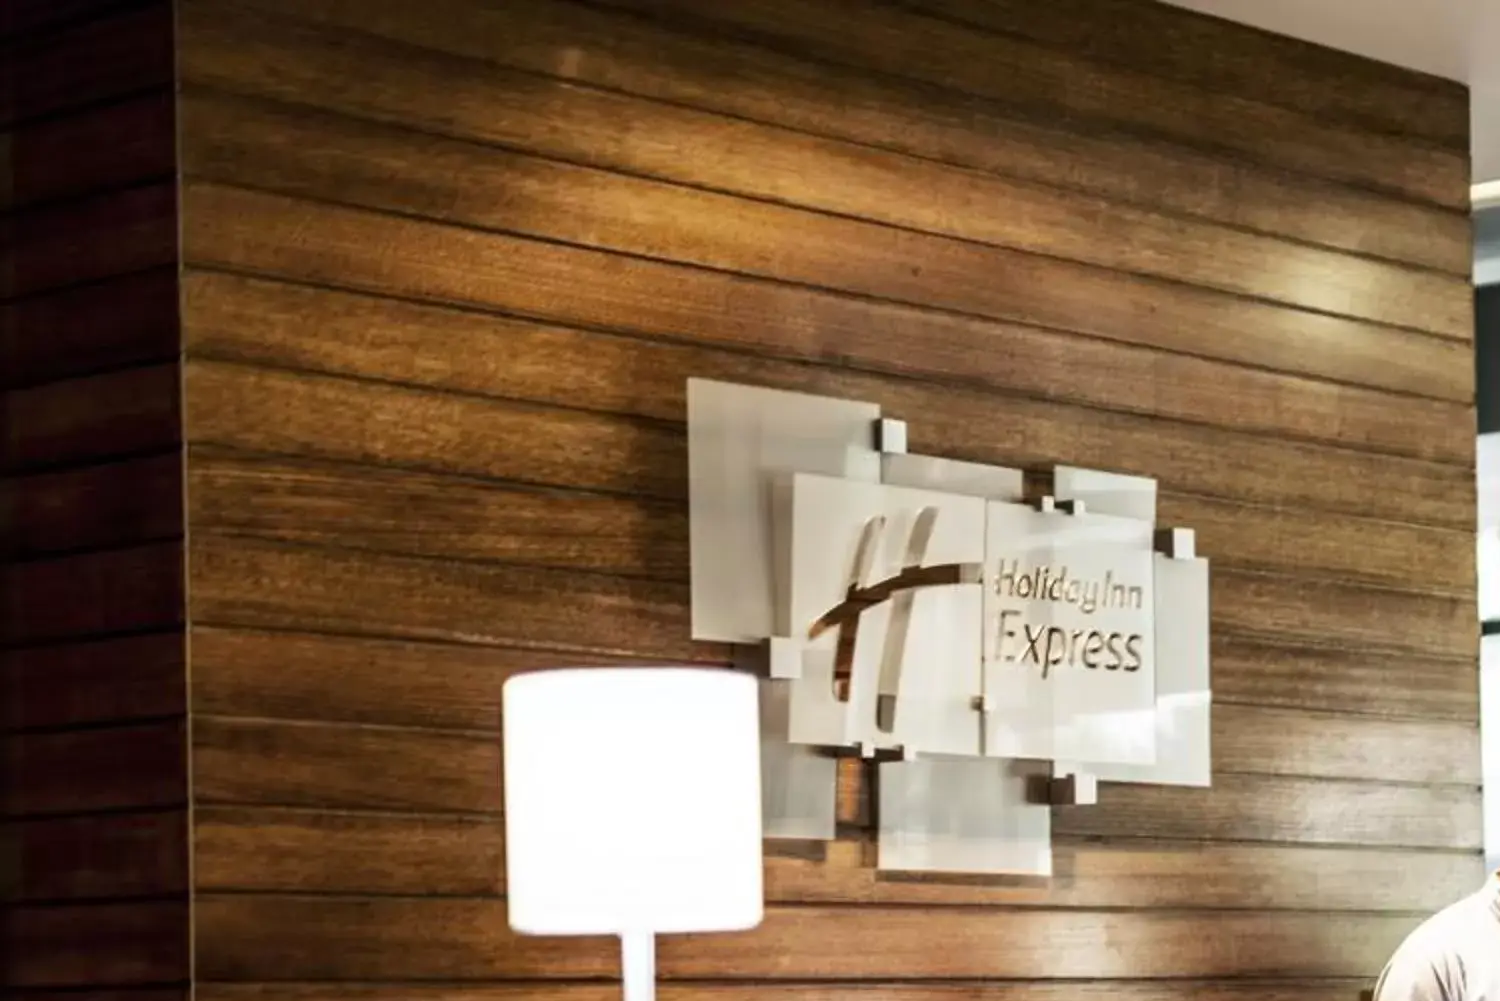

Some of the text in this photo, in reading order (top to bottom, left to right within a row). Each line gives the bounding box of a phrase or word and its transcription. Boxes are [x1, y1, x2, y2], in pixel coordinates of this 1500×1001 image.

[995, 559, 1143, 614] Holiday Inn
[996, 609, 1143, 680] Express
